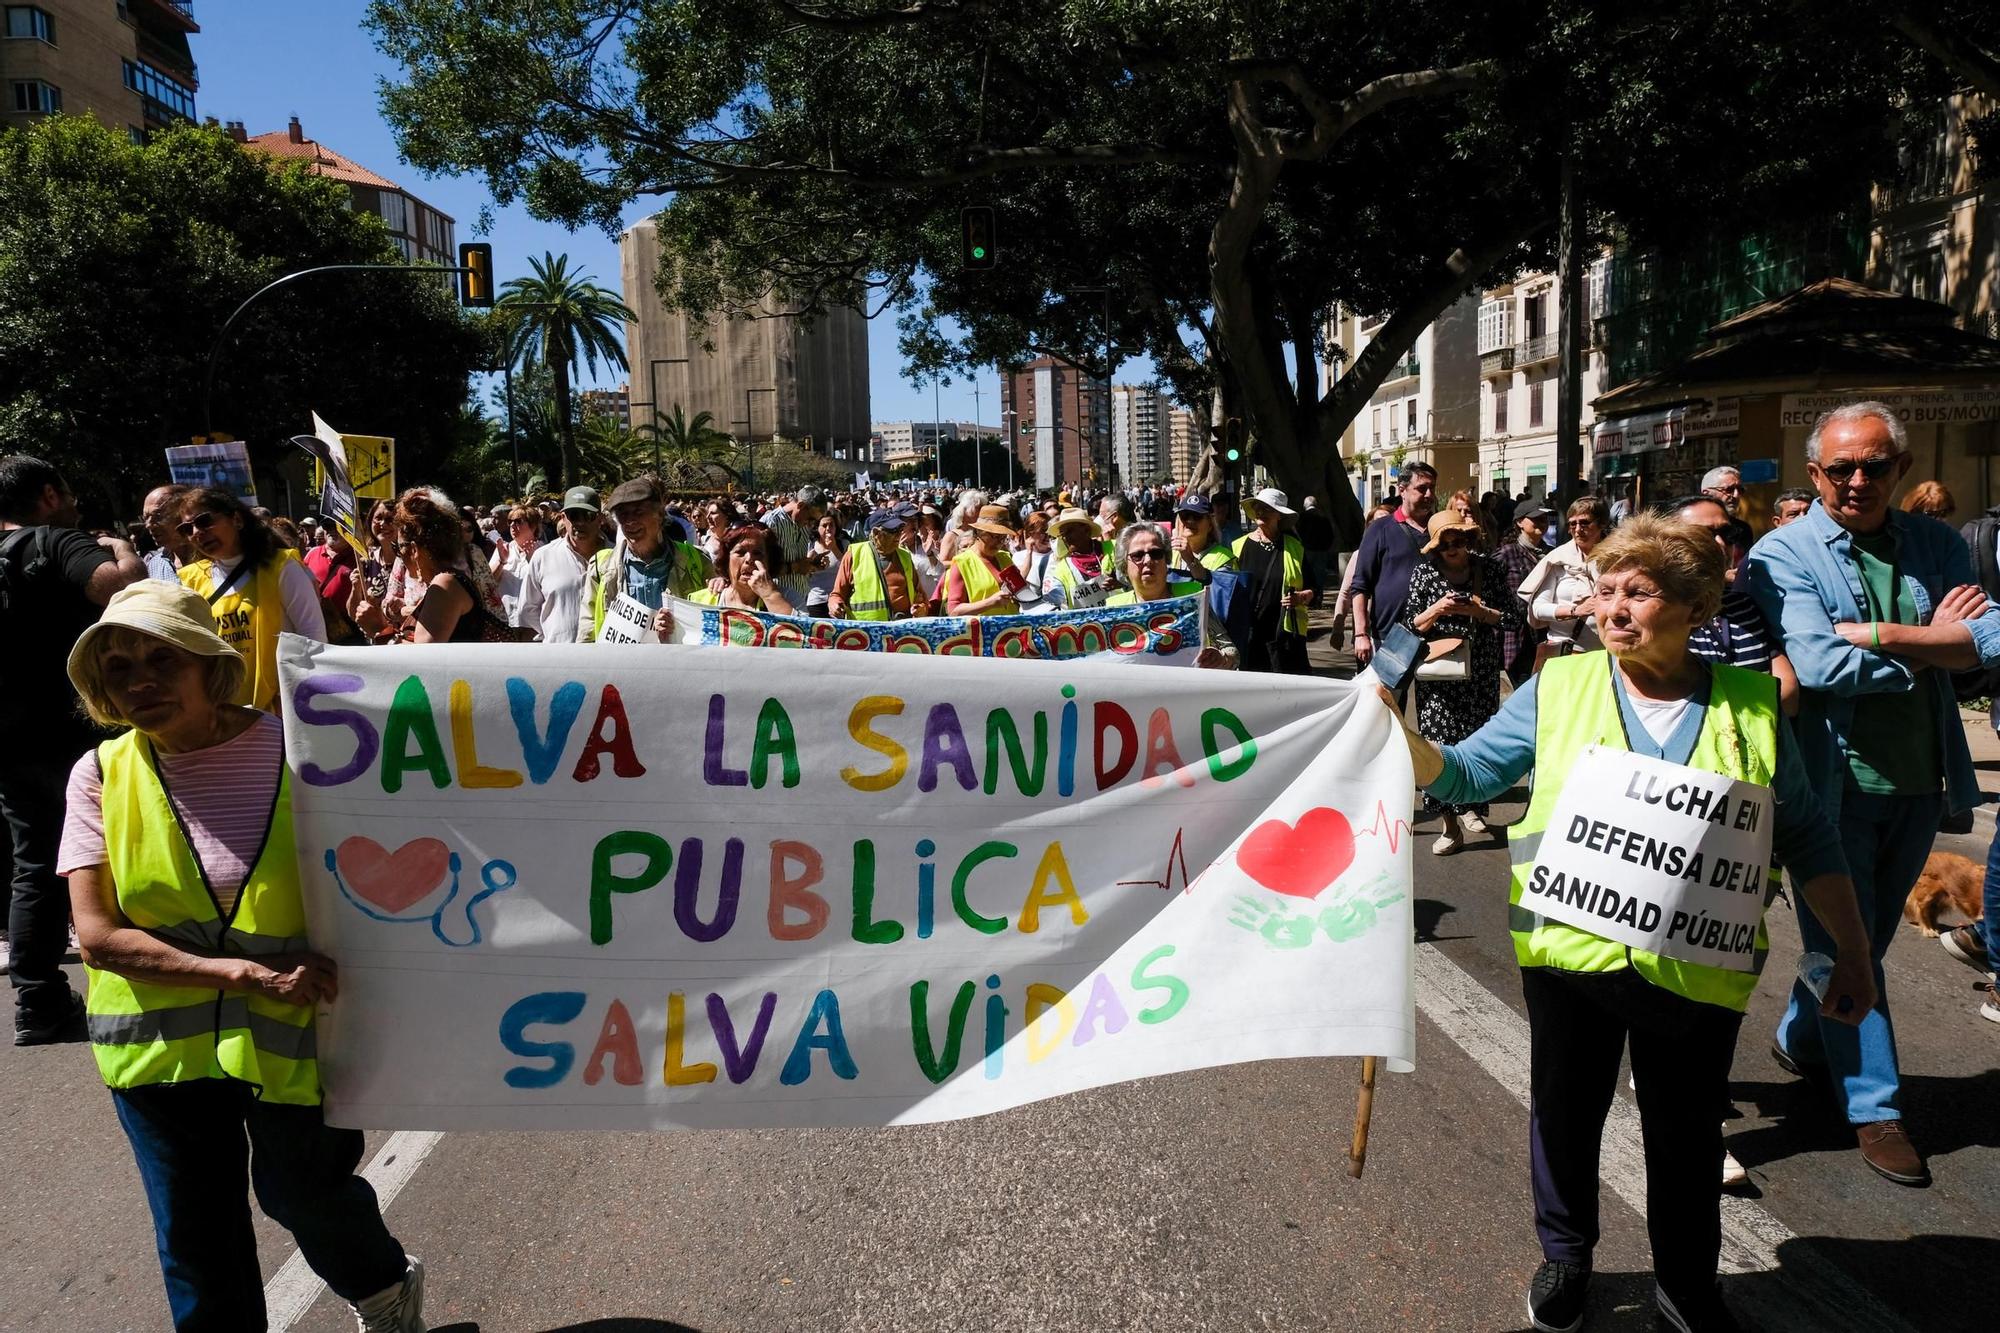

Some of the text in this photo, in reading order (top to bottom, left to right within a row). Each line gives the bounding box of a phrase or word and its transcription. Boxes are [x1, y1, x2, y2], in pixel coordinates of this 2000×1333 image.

[605, 626, 619, 644] EN
[610, 598, 635, 621] MILES
[634, 610, 648, 629] DE
[719, 607, 1183, 657] Defendamos
[293, 674, 646, 794] SALVA
[704, 693, 800, 789] LA
[1625, 770, 1760, 832] LUCHA EN
[1566, 814, 1760, 895] DEFENSA DE LA
[1529, 865, 1755, 955] SANIDAD PÚBLICA
[500, 989, 860, 1089] SALVA
